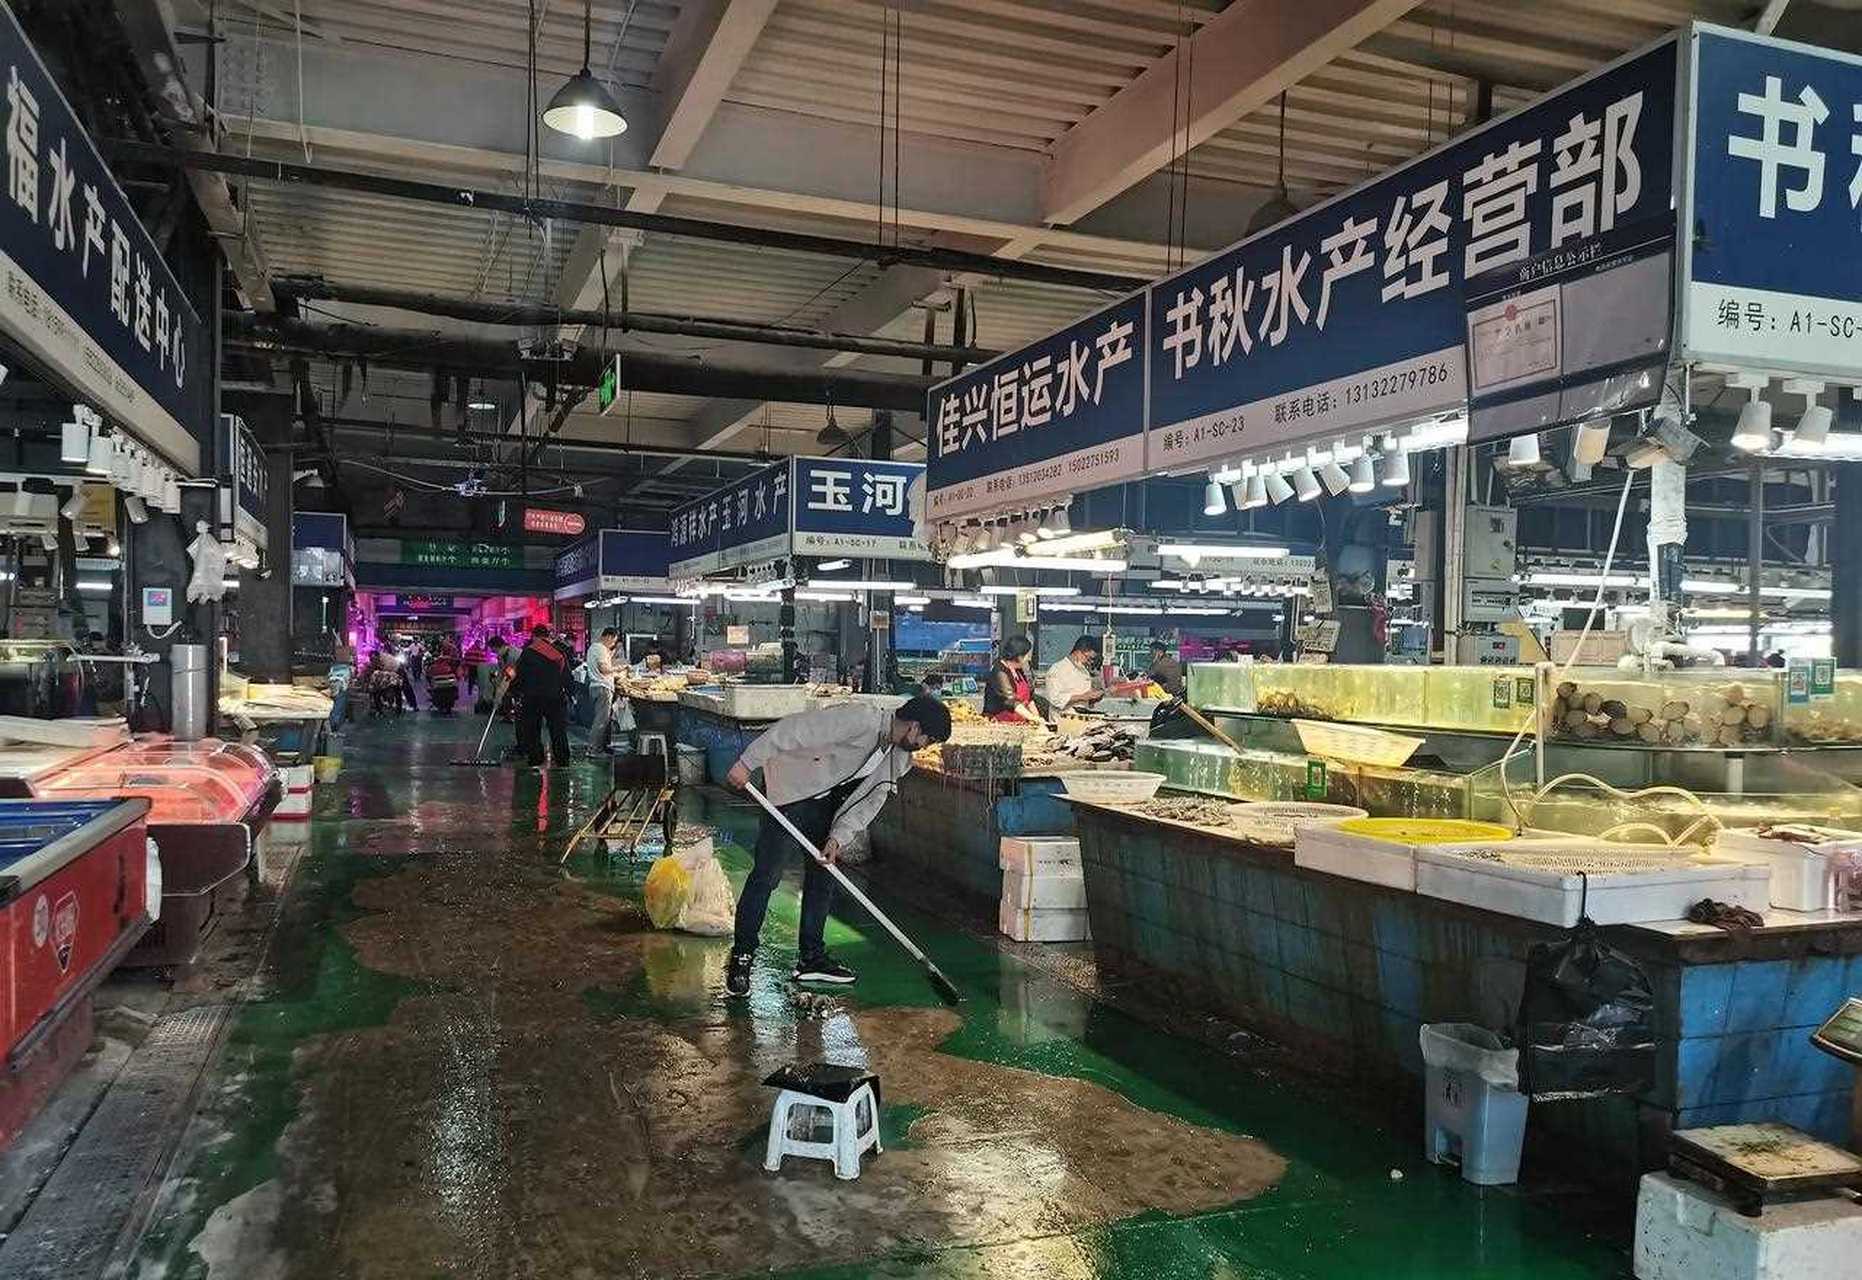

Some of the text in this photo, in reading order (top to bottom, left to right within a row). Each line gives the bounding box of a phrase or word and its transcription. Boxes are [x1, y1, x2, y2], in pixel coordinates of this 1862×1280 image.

[7, 65, 185, 388] 福水产配送中心
[1163, 91, 1643, 379] 书秋水产经营部
[937, 321, 1133, 458] 佳兴恒运水产
[723, 471, 787, 530] 玉河水产
